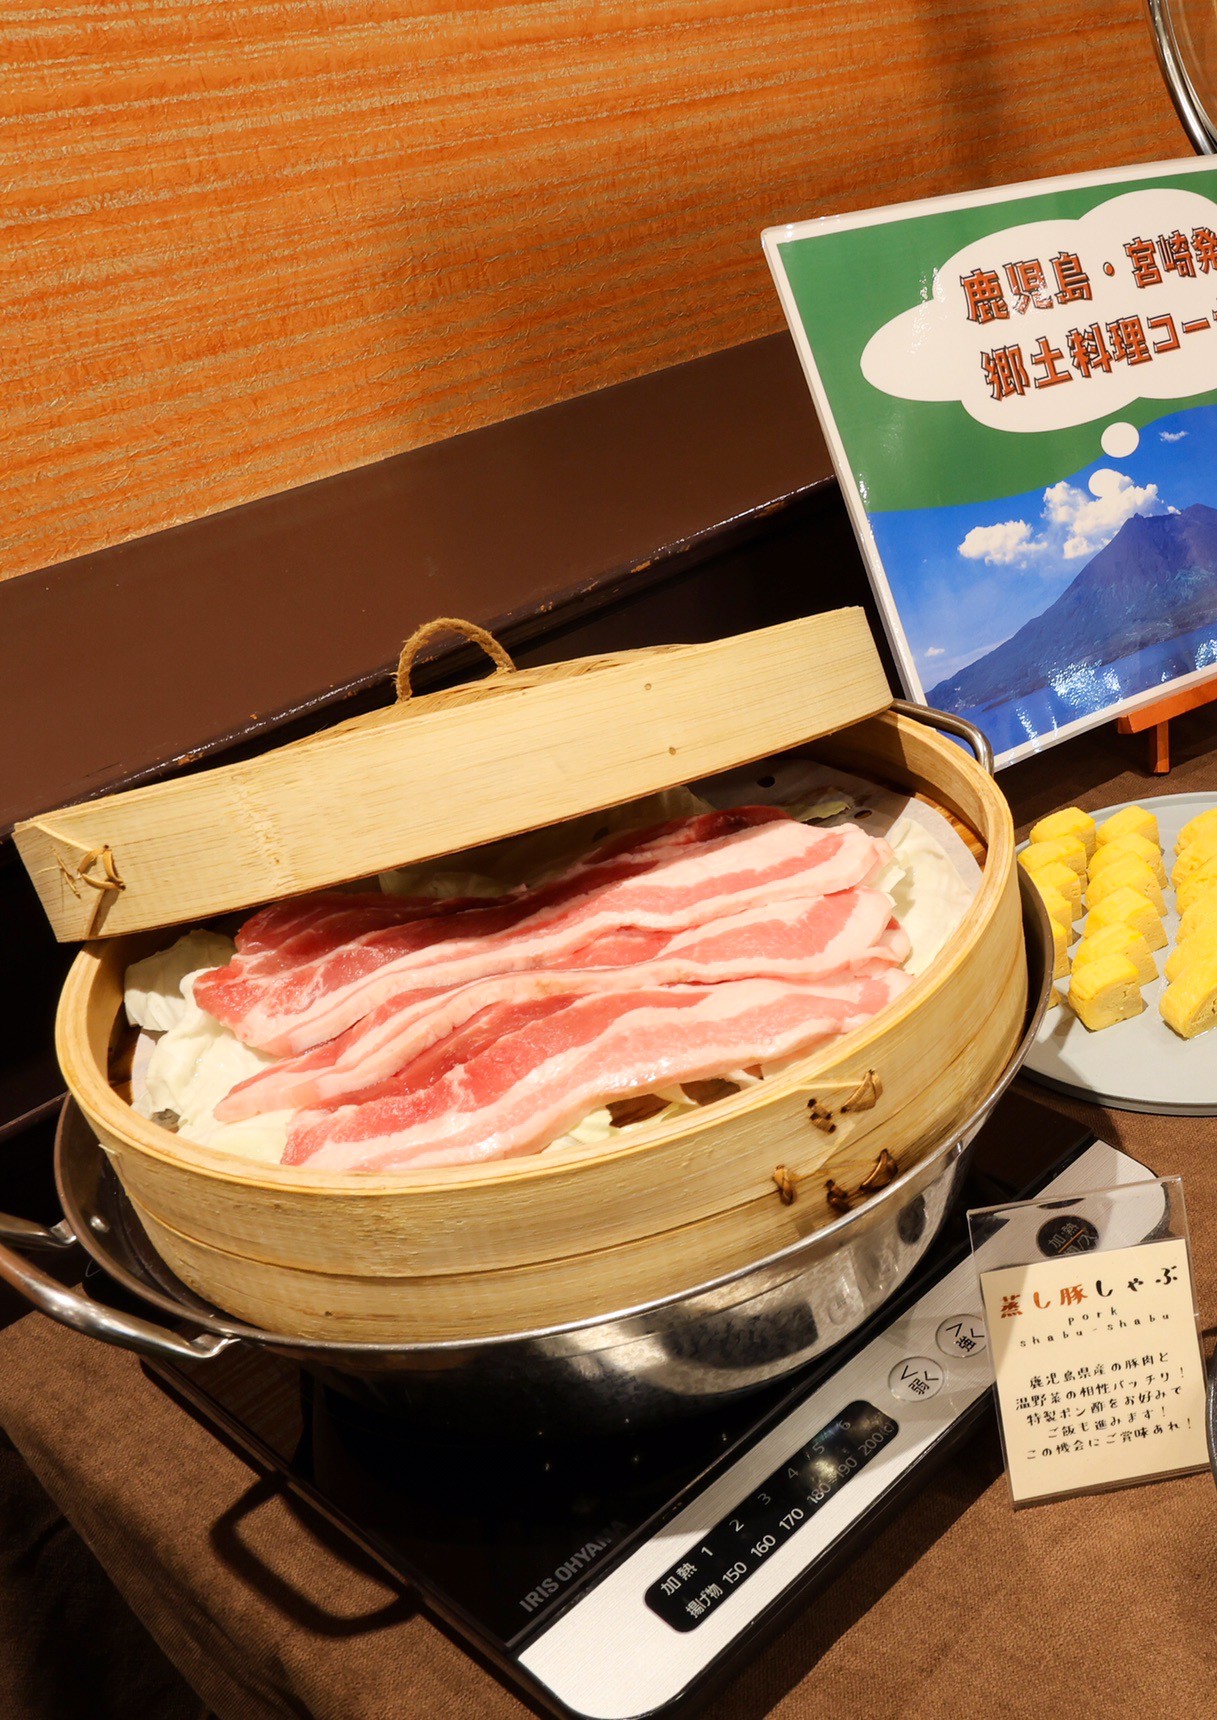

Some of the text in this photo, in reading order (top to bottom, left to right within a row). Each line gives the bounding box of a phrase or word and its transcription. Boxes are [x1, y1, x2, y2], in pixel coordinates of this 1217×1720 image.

[1000, 1265, 1178, 1319] 蒸し豚しゃぶ
[1015, 1366, 1185, 1411] 温野菜の相性バッチリ！
[1029, 1352, 1169, 1390] 鹿児島県産の豚肉と
[1026, 1386, 1182, 1427] 特製ポン酢をお好みで
[1048, 1406, 1166, 1439] ご飯も進みます！
[1026, 1418, 1192, 1460] この機会にご賞味あれ！
[660, 1419, 851, 1596] 加熱 1 2 3 4 5 6
[685, 1582, 724, 1619] 揚げ物
[722, 1561, 748, 1585] 150
[750, 1534, 776, 1558] 160
[779, 1507, 804, 1531] 170
[806, 1482, 831, 1504] 180
[836, 1456, 858, 1479] 190
[857, 1432, 884, 1457] 200
[519, 1577, 560, 1613] IRIS
